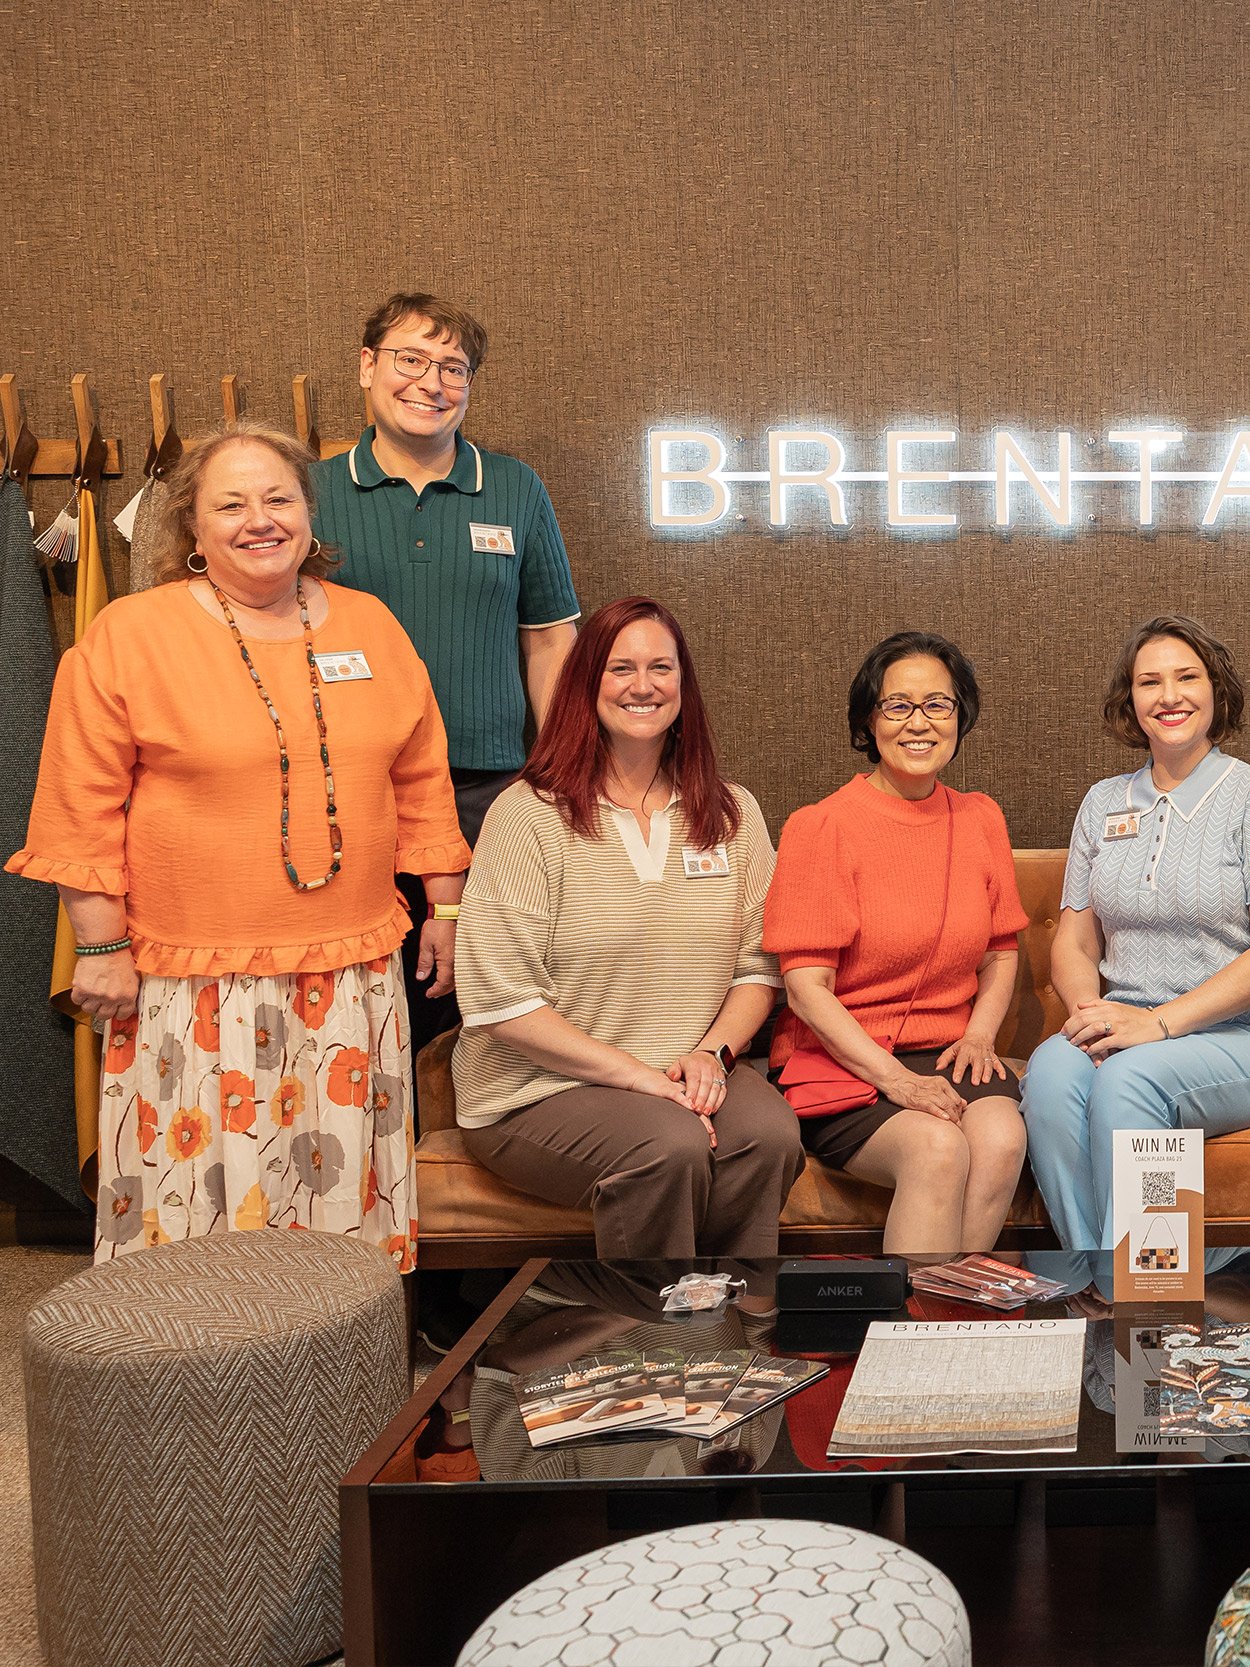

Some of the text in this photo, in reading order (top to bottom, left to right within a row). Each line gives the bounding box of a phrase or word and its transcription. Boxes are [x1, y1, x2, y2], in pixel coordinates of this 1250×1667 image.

[1131, 1137, 1186, 1153] WIN ME
[983, 1261, 1029, 1278] BRENTANO
[817, 1285, 863, 1297] ANKER
[891, 1321, 1058, 1332] BRENTANO
[582, 1362, 635, 1381] COLLECTION
[687, 1364, 739, 1373] COLLECTION
